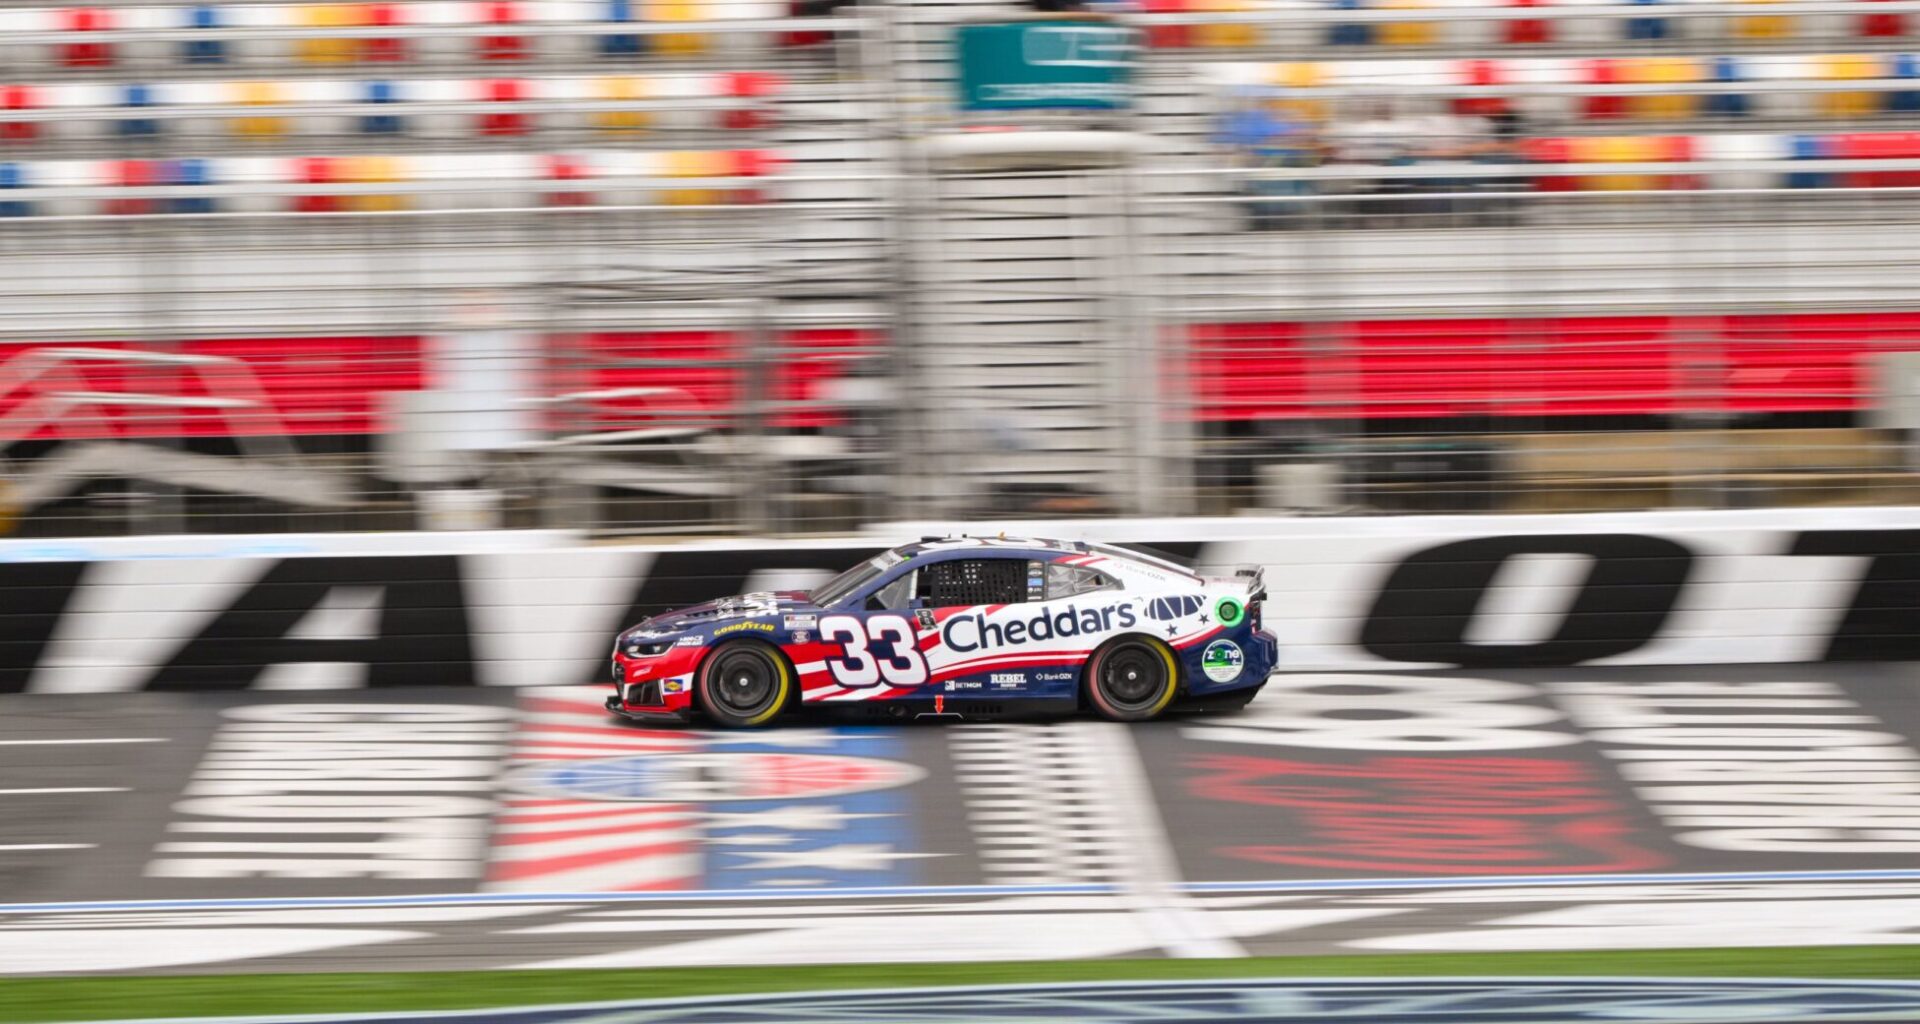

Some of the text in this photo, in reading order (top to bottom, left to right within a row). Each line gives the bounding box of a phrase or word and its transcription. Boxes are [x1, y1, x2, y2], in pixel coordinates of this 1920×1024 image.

[714, 620, 775, 636] GOODYEAR
[818, 615, 928, 685] 33
[990, 673, 1027, 684] REBEL
[1044, 673, 1059, 681] Bank
